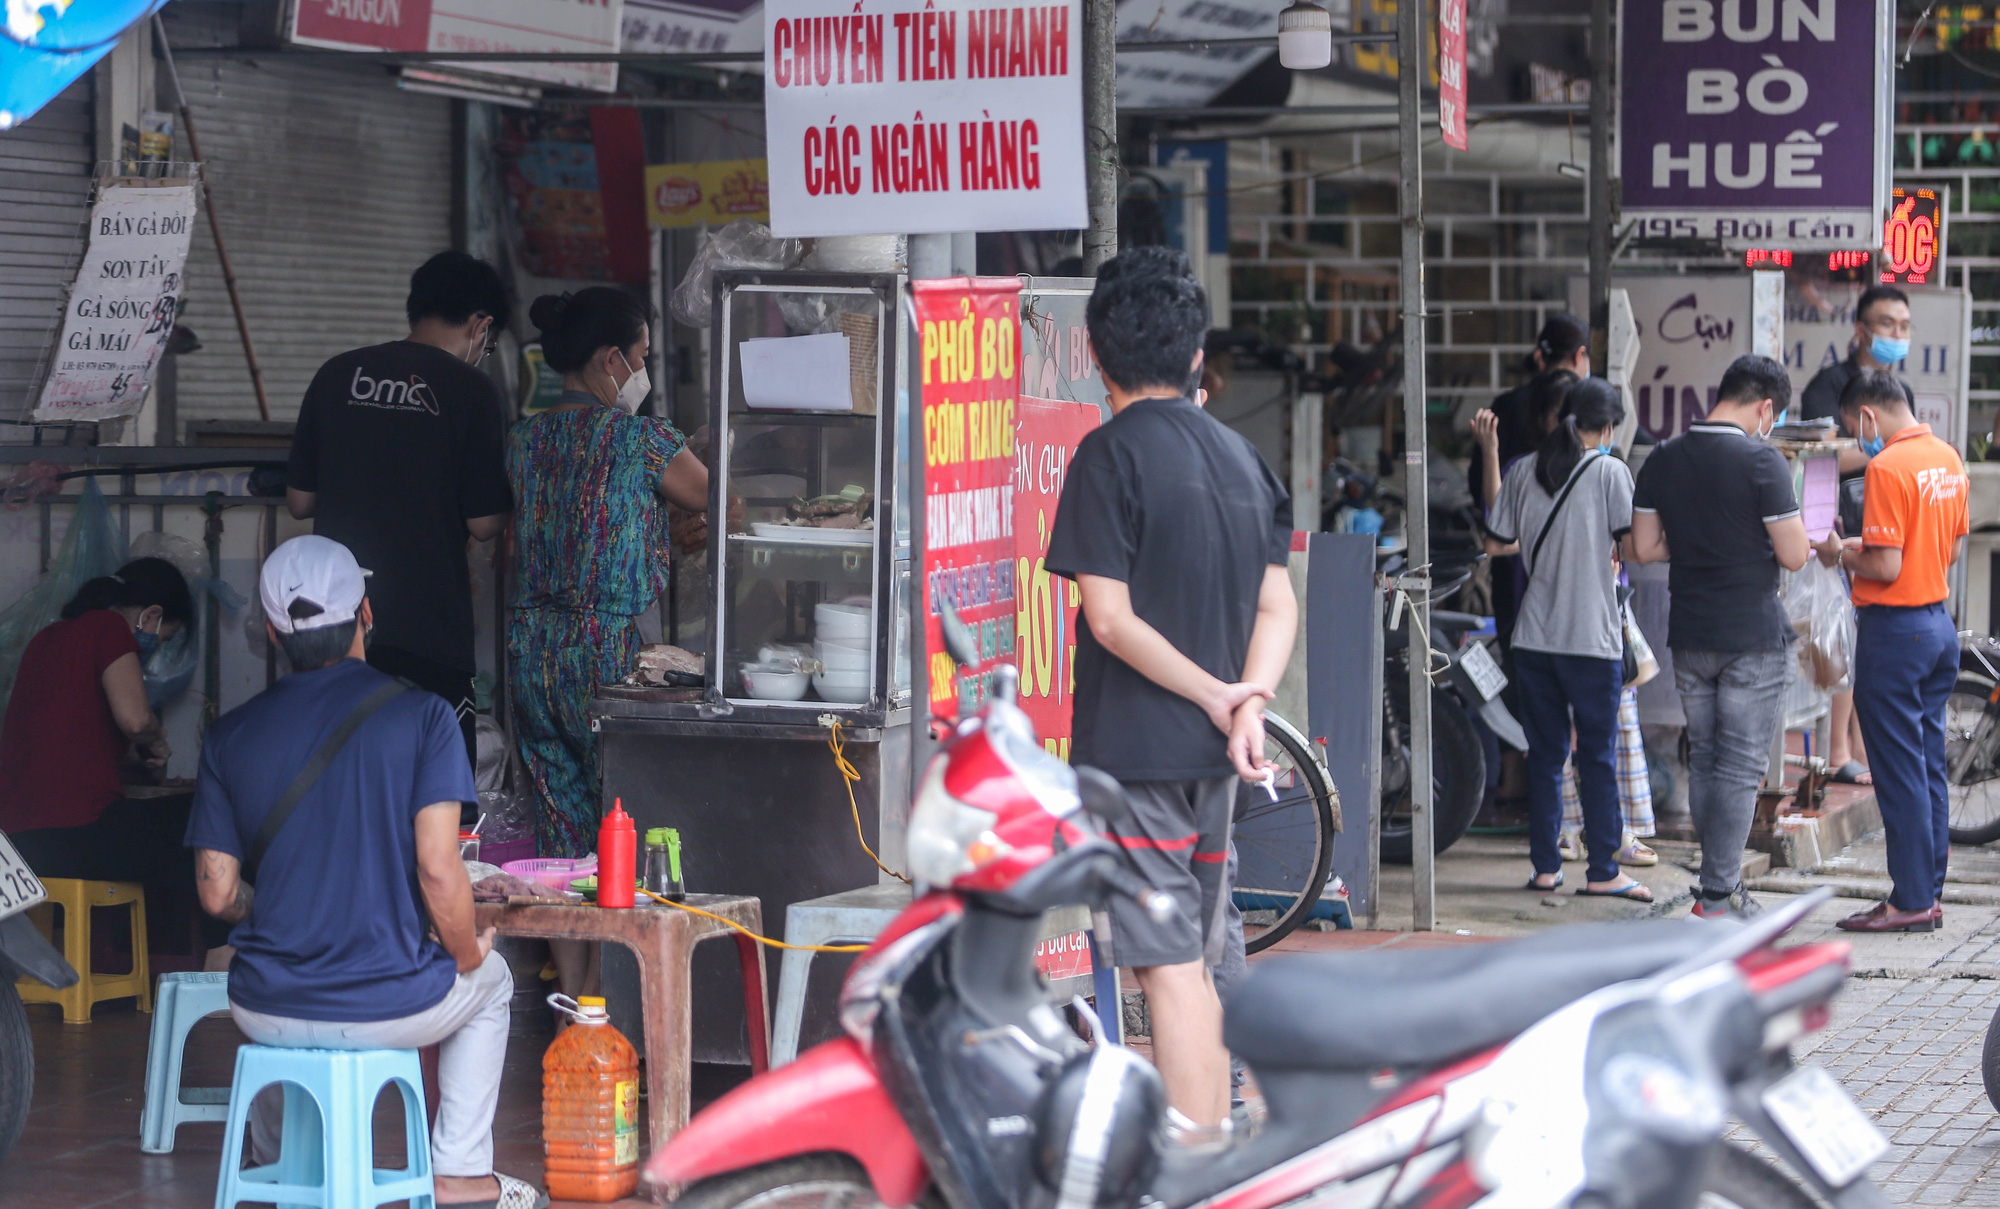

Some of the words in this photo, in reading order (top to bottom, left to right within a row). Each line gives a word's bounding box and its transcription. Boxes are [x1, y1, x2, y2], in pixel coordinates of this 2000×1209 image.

[968, 5, 1069, 79] NHANH
[1686, 53, 1809, 115] BÒ
[804, 115, 861, 196] CÁC
[871, 110, 950, 193] NGÂN
[959, 109, 1040, 191] HÀNG
[1652, 121, 1839, 189] HUẾ
[100, 211, 134, 235] BÁN
[137, 211, 158, 235] GÀ
[924, 297, 975, 385] PHỞ
[981, 302, 1015, 380] BÒ
[351, 366, 427, 406] bmc
[924, 398, 965, 466] CƠM
